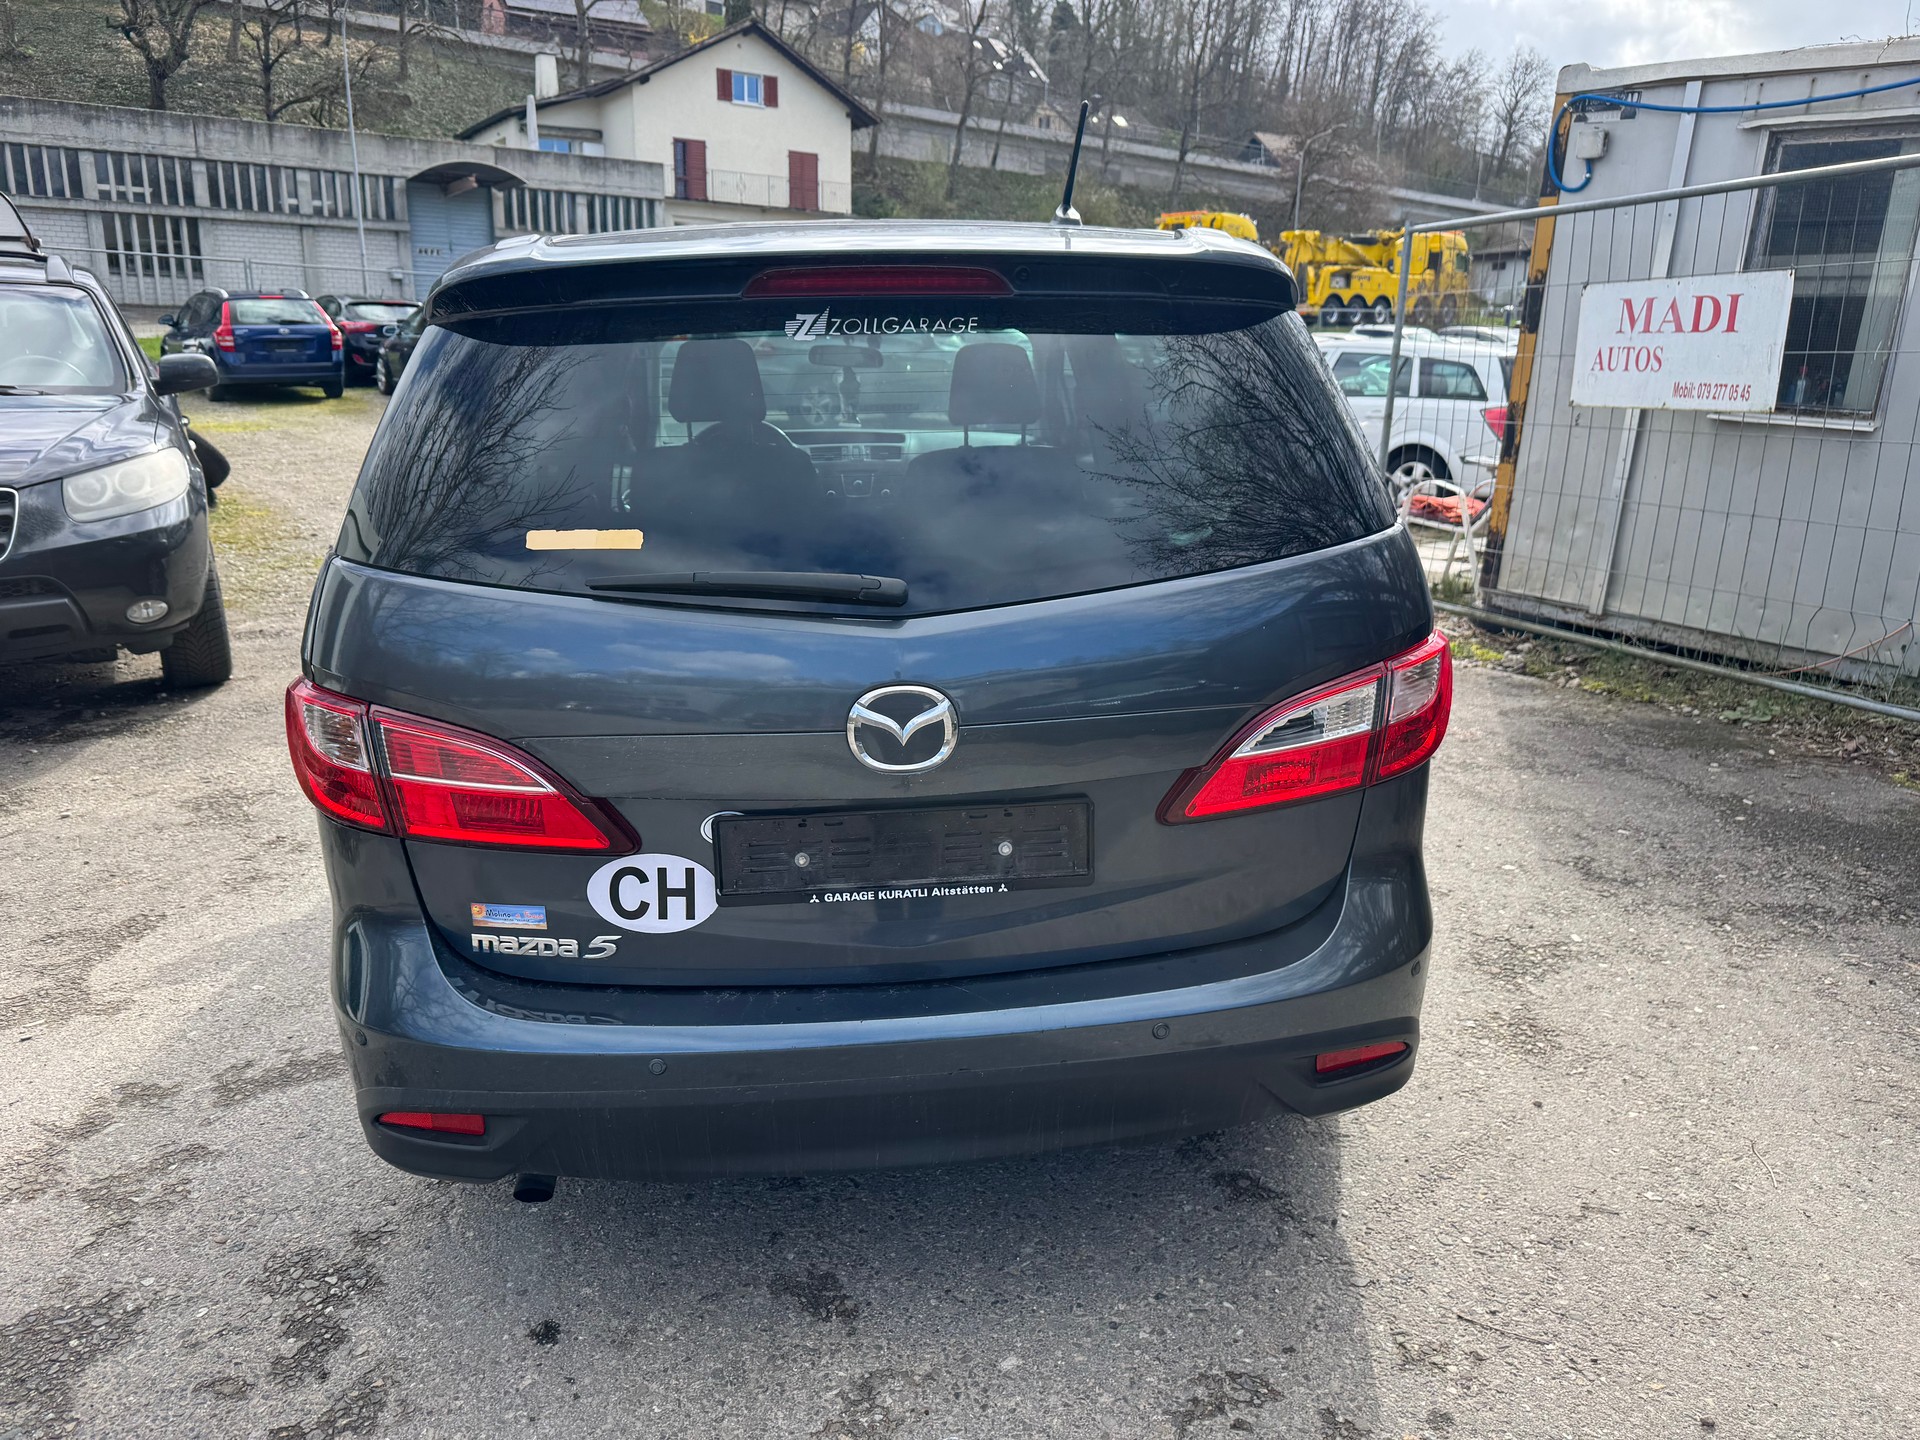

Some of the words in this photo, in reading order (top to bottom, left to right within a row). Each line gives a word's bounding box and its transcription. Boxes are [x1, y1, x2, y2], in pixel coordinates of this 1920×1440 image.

[828, 316, 979, 336] ZOLLGARAGE
[1615, 293, 1745, 335] MADI
[1590, 345, 1664, 373] AUTOS
[1671, 380, 1696, 399] Mobil:
[1697, 382, 1712, 400] 079
[1712, 383, 1728, 401] 277
[1728, 384, 1740, 401] 05
[1740, 384, 1752, 402] 45
[608, 866, 696, 921] CH
[824, 891, 876, 903] GARAGE
[878, 887, 929, 901] KURATLI
[931, 883, 995, 898] Altstätten
[582, 935, 623, 959] 5
